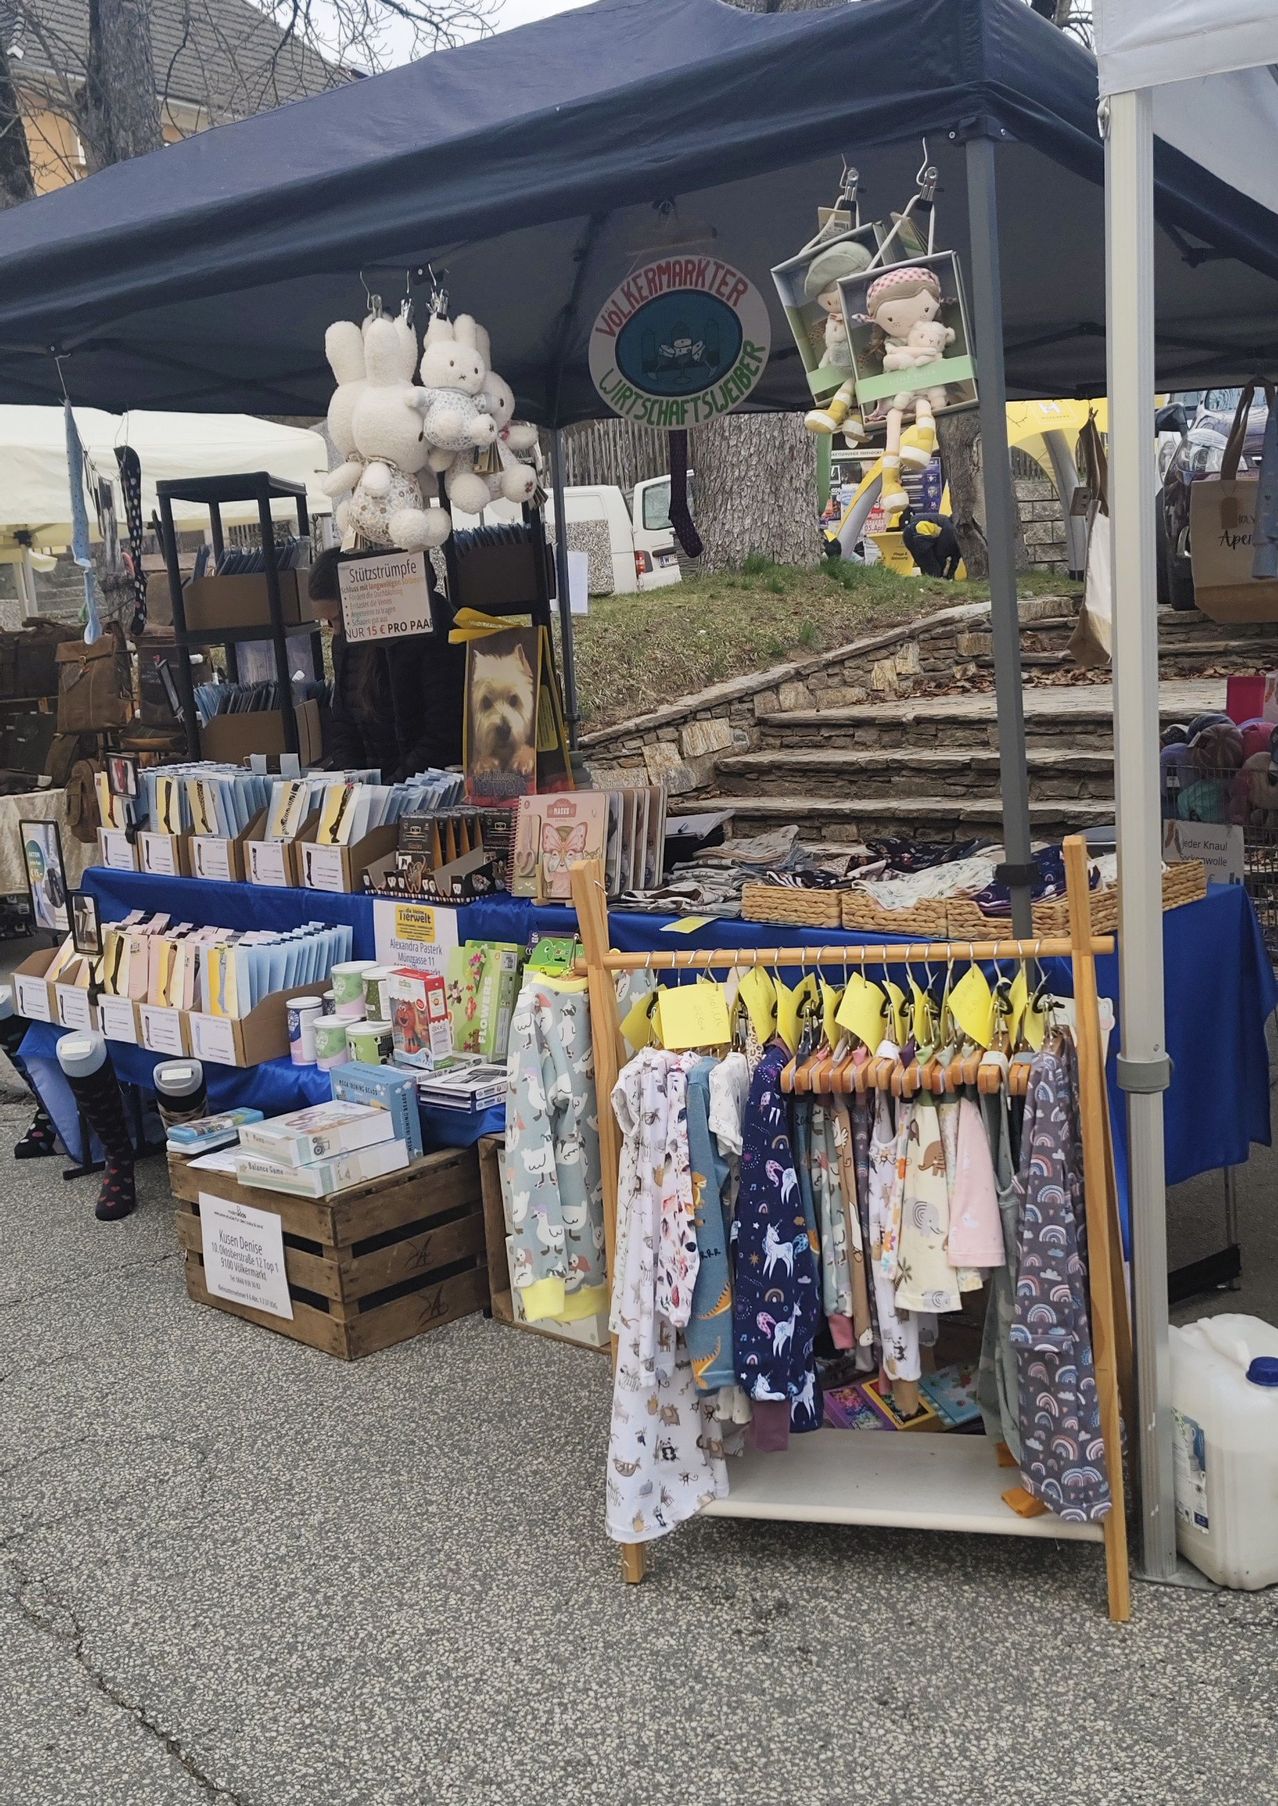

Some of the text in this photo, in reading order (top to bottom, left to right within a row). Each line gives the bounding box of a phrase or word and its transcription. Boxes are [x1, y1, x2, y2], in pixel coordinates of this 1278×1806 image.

[595, 257, 748, 338] VÖLKERMARKTER
[599, 339, 766, 426] WIRTSCHAFTSWEIBER
[349, 559, 417, 583] Stützstrümpfe
[345, 627, 365, 638] NUR
[367, 625, 377, 636] 15
[380, 624, 386, 634] €
[387, 621, 408, 634] PRO
[1180, 854, 1228, 867] Soknwolle
[399, 912, 432, 924] Tierwelt
[390, 938, 443, 955] Alexandra Pasterk
[428, 956, 435, 966] 11
[479, 976, 491, 1044] FLOWERS
[239, 1236, 263, 1256] Denise
[255, 1257, 263, 1269] 12
